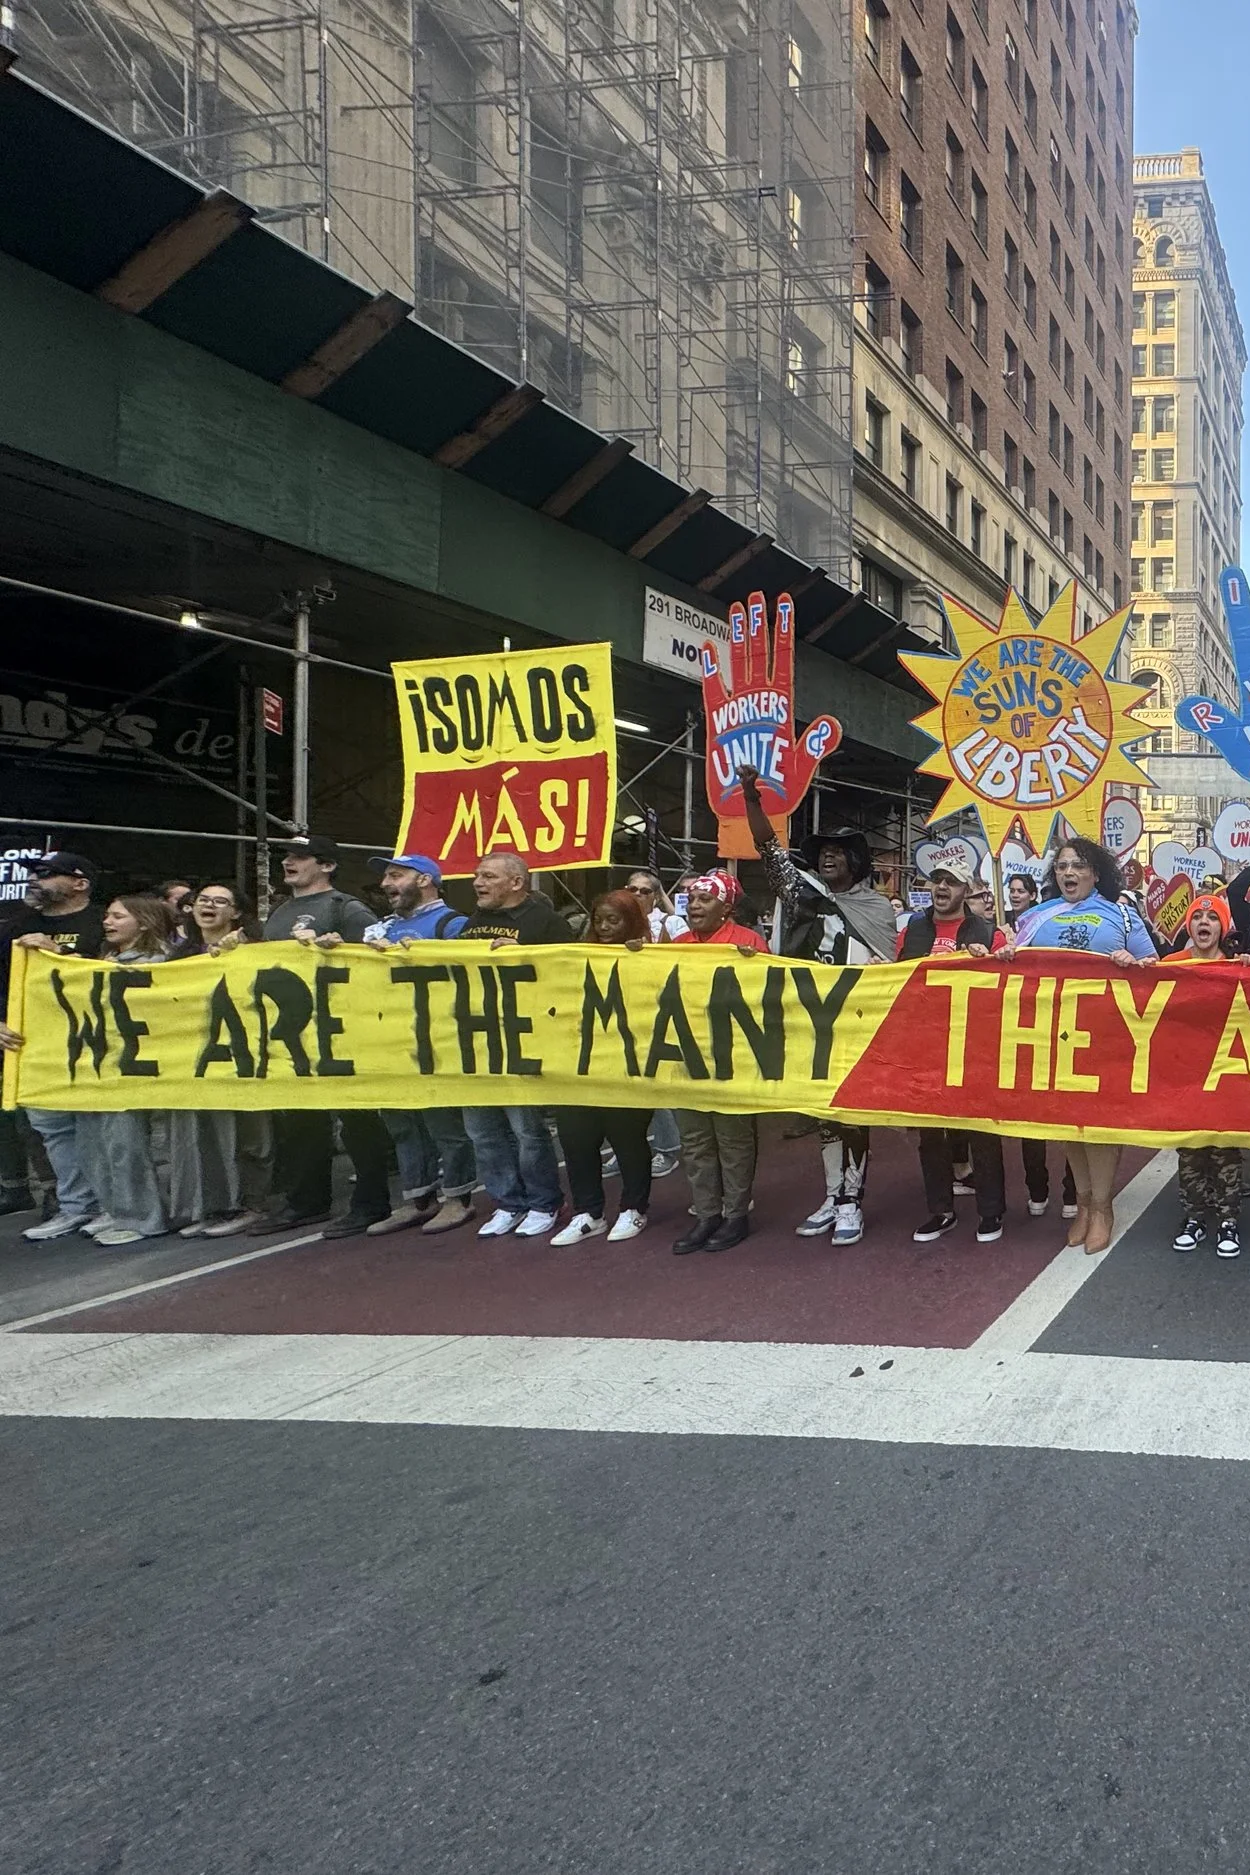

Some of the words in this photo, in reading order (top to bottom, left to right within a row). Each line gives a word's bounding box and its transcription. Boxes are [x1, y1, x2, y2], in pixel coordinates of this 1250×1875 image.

[649, 595, 670, 616] 291
[952, 659, 993, 698] WE
[998, 639, 1044, 669] ARE
[1049, 647, 1091, 689] THE
[712, 692, 788, 734] WORKERS
[973, 671, 1064, 724] SUNS
[1011, 712, 1035, 738] OF
[712, 733, 789, 786] UNITE
[951, 706, 1110, 803] LIBERTY
[439, 766, 590, 861] MÁS!
[928, 845, 965, 860] WORKERS
[1006, 861, 1042, 877] WORKERS
[1174, 856, 1206, 868] WORKERS
[1147, 883, 1165, 904] HANDS
[1161, 902, 1174, 919] OUR
[1164, 892, 1190, 931] HISTORY
[51, 967, 160, 1082] WE
[195, 966, 356, 1079] ARE
[391, 963, 542, 1076] THE
[577, 959, 863, 1081] MANY
[926, 969, 1176, 1093] THEY
